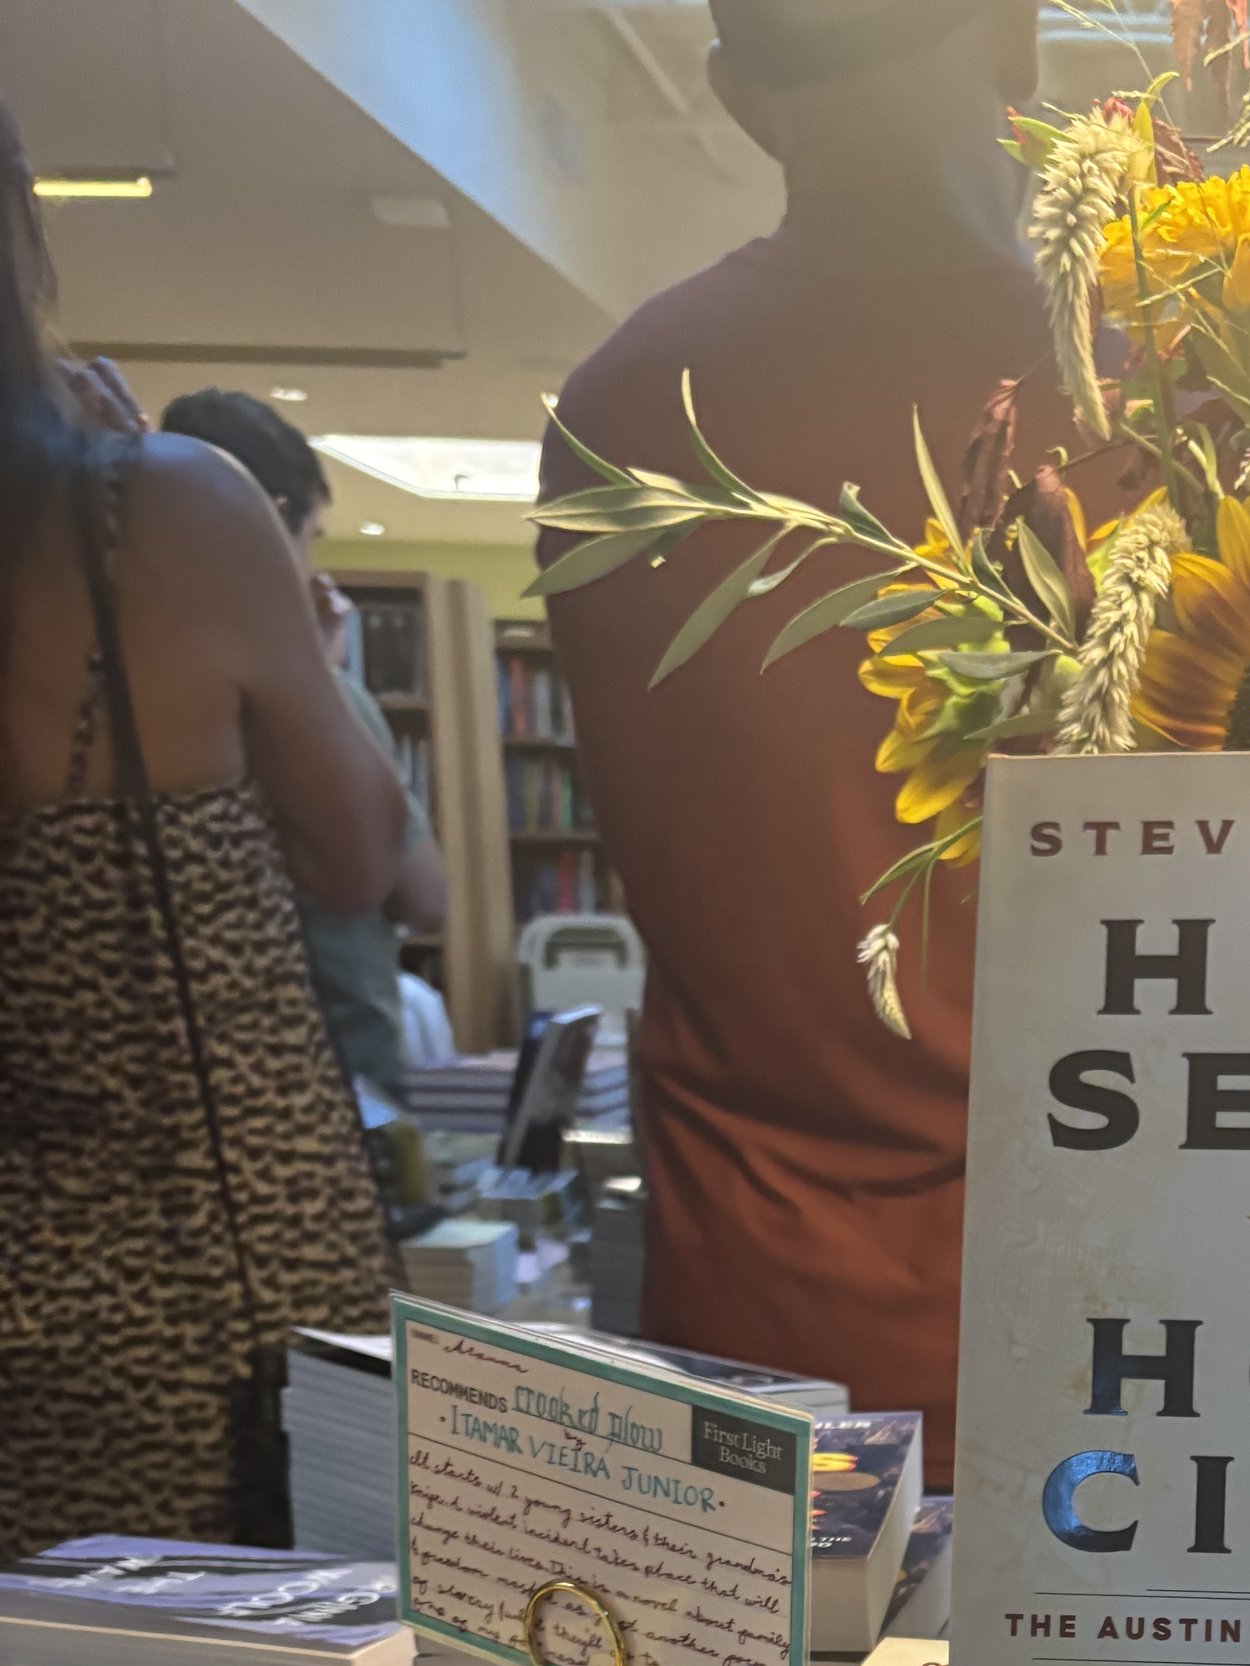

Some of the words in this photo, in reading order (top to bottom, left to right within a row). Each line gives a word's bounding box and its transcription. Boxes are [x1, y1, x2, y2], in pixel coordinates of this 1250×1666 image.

[411, 1369, 508, 1413] RECOMMENDS
[451, 1405, 523, 1455] ITAMAR
[528, 1436, 610, 1480] VIEIRA
[622, 1466, 716, 1513] JUNIOR
[704, 1421, 740, 1443] First
[743, 1432, 783, 1460] Light
[719, 1447, 766, 1475] Books
[511, 1485, 519, 1498] 2
[524, 1497, 571, 1528] young
[579, 1508, 637, 1540] sisters
[654, 1533, 697, 1559] their
[645, 1561, 696, 1585] place
[745, 1584, 779, 1614] will
[1005, 1613, 1077, 1639] THE
[1097, 1614, 1242, 1644] AUSTIN
